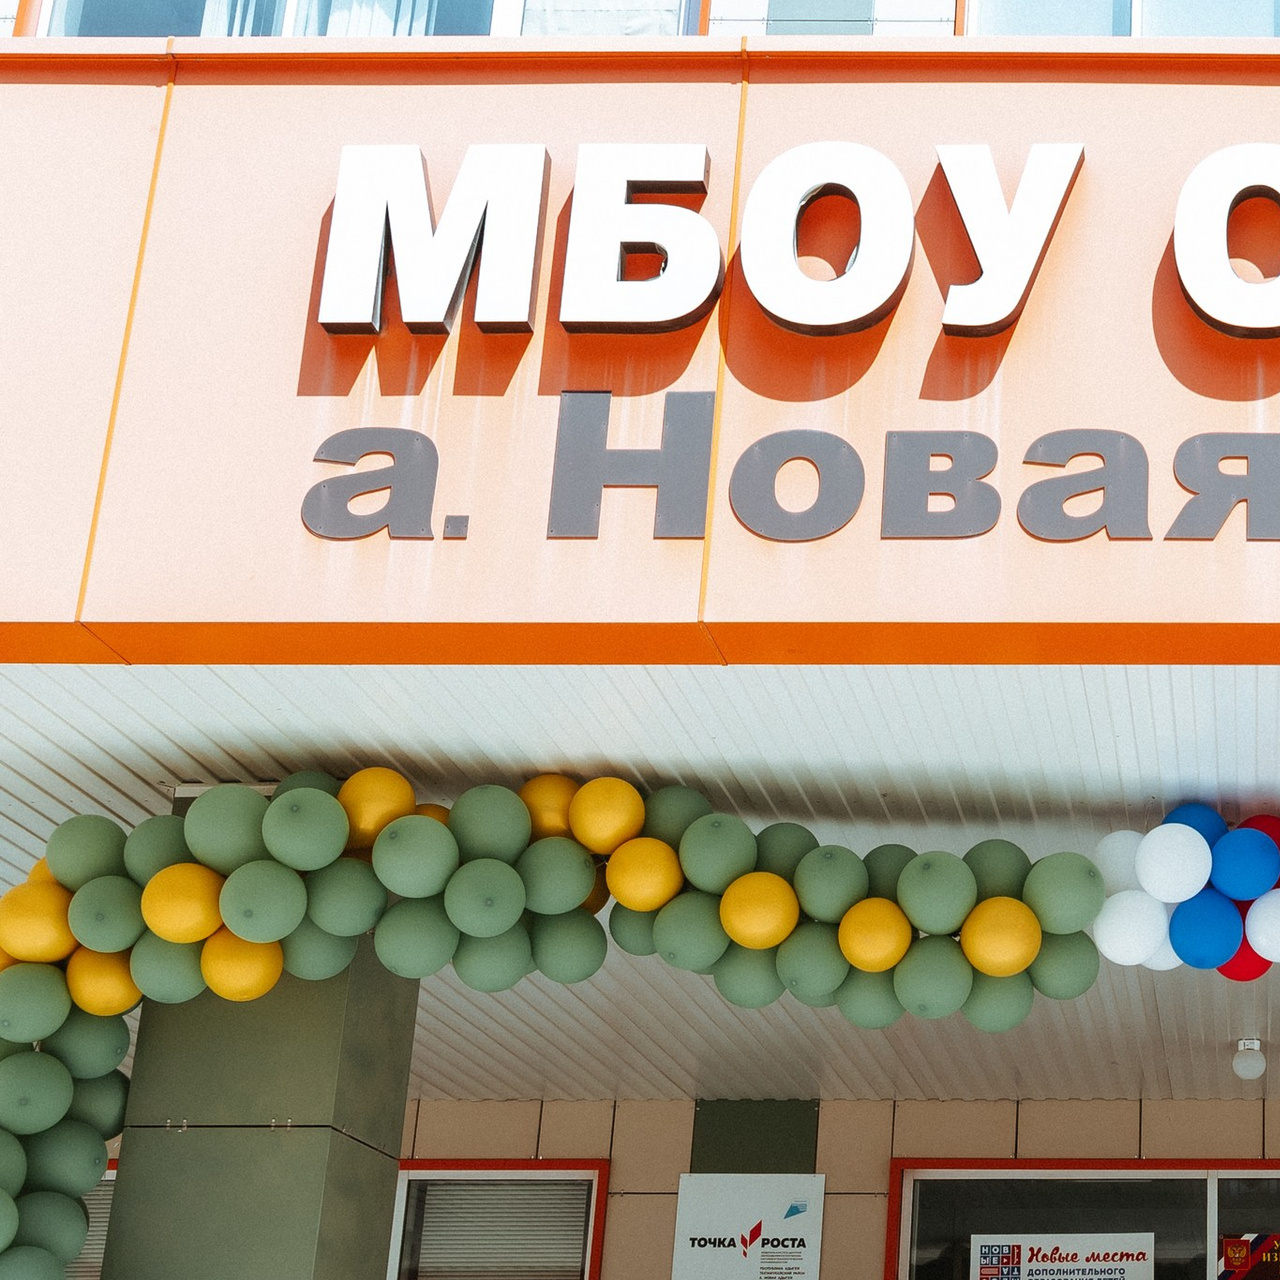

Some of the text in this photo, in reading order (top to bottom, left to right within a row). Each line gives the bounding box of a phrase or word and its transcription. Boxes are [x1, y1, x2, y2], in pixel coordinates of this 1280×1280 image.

[319, 141, 1084, 337] МБОУ
[301, 426, 469, 542] а.
[689, 1237, 806, 1249] ТОЧКА РОСТА
[1027, 1246, 1148, 1263] Новые места
[1027, 1268, 1126, 1277] ДОПОЛНИТЕЛЬНОГО
